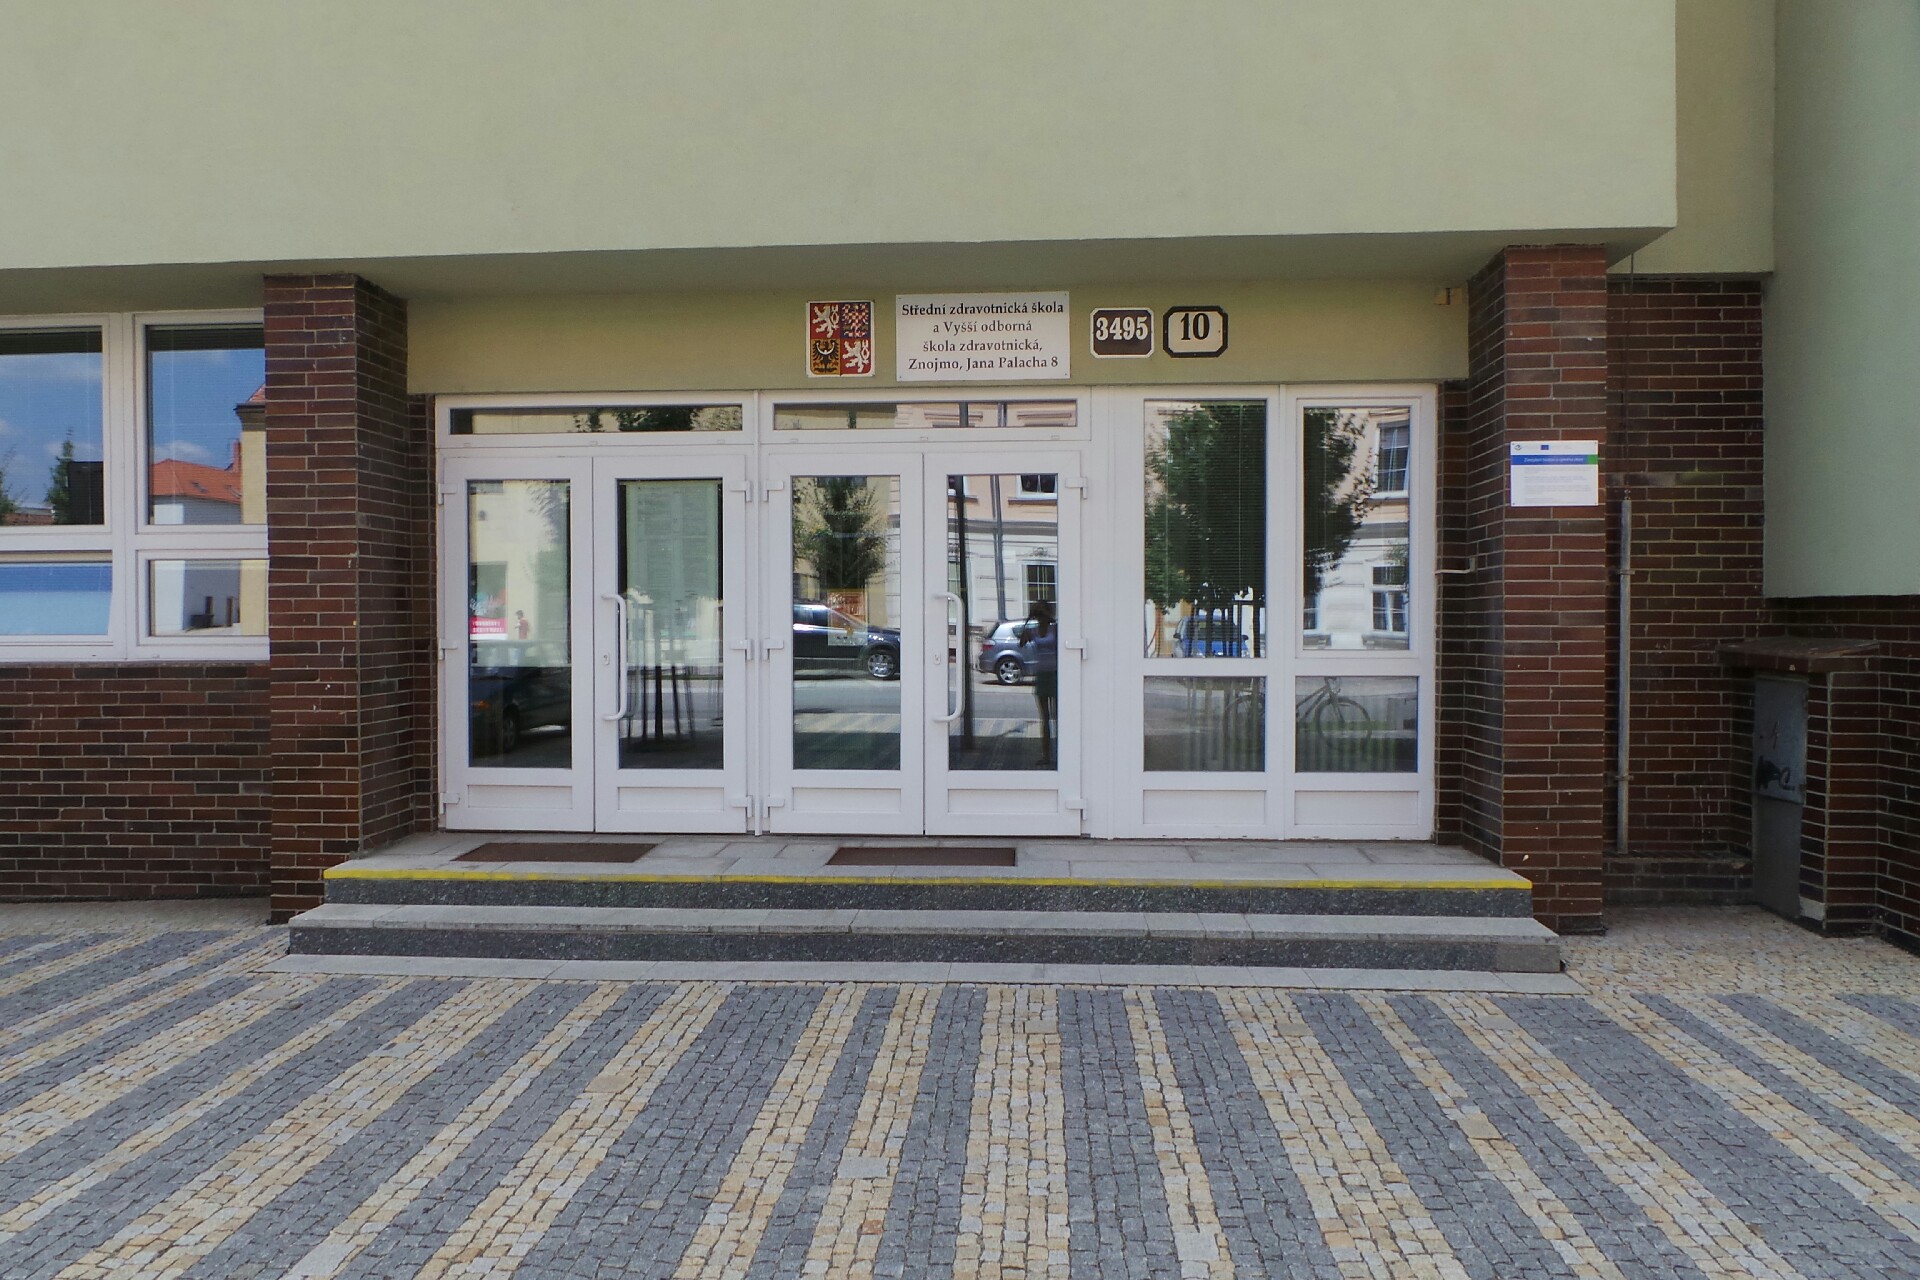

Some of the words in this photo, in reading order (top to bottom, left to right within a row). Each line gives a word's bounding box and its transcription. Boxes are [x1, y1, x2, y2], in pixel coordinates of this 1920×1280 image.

[901, 303, 946, 316] Střední
[950, 302, 1028, 315] zdravotnická
[1031, 301, 1064, 314] škola
[933, 324, 939, 333] a
[943, 321, 977, 336] Vyšší
[981, 320, 1032, 332] odborná
[1095, 316, 1149, 341] 3495
[1180, 312, 1210, 341] 10
[923, 340, 956, 352] škola
[959, 339, 1043, 352] zdravotnická,
[908, 358, 963, 373] Znojmo,
[966, 357, 994, 371] Jana
[999, 356, 1047, 369] Palacha
[1051, 356, 1059, 367] 8
